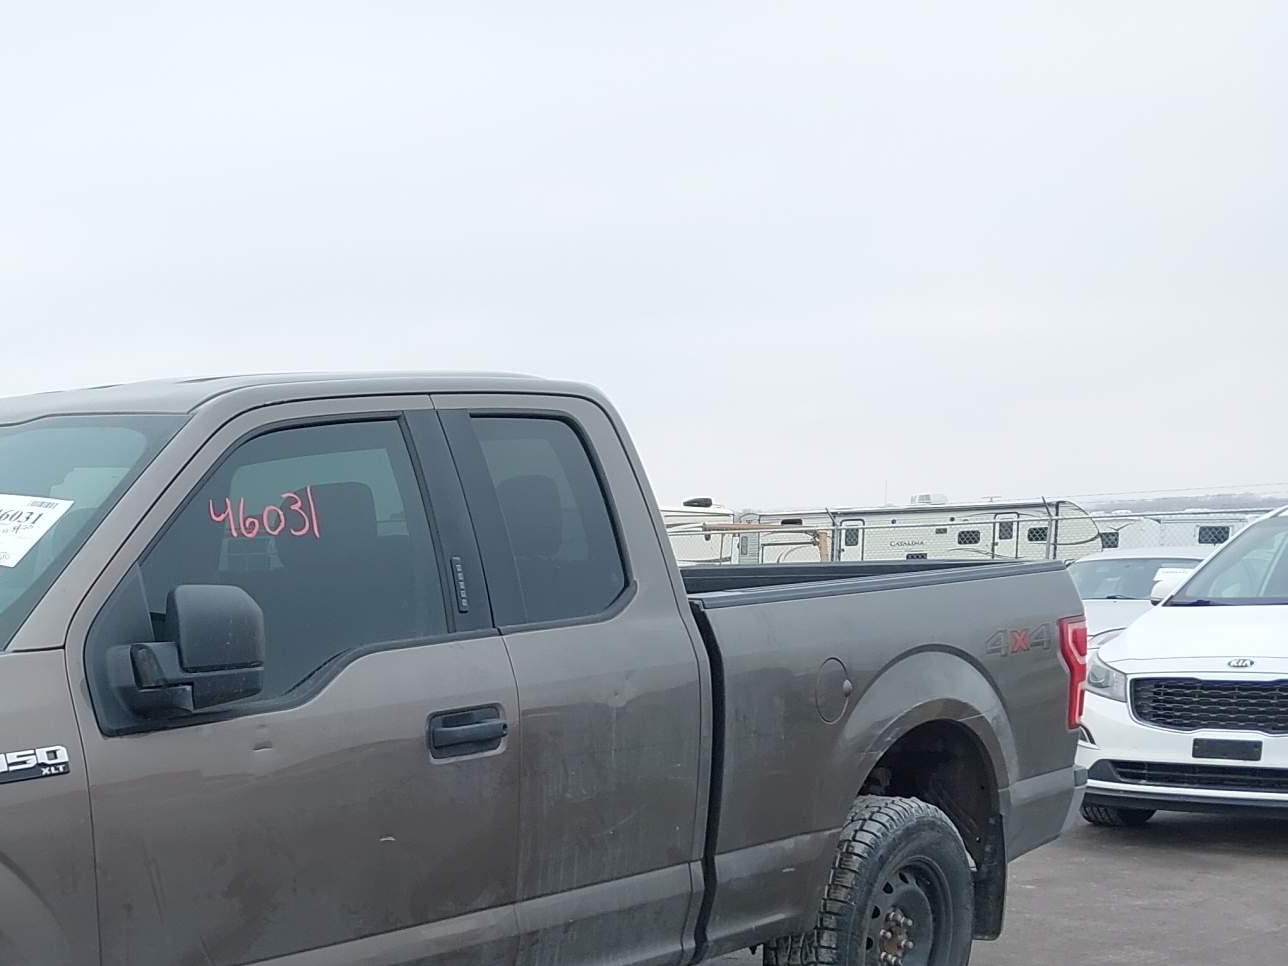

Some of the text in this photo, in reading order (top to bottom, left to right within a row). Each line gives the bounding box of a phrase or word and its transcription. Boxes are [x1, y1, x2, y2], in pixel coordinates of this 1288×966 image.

[209, 485, 320, 539] 46031
[1229, 659, 1252, 668] KIA
[40, 764, 66, 776] XLT
